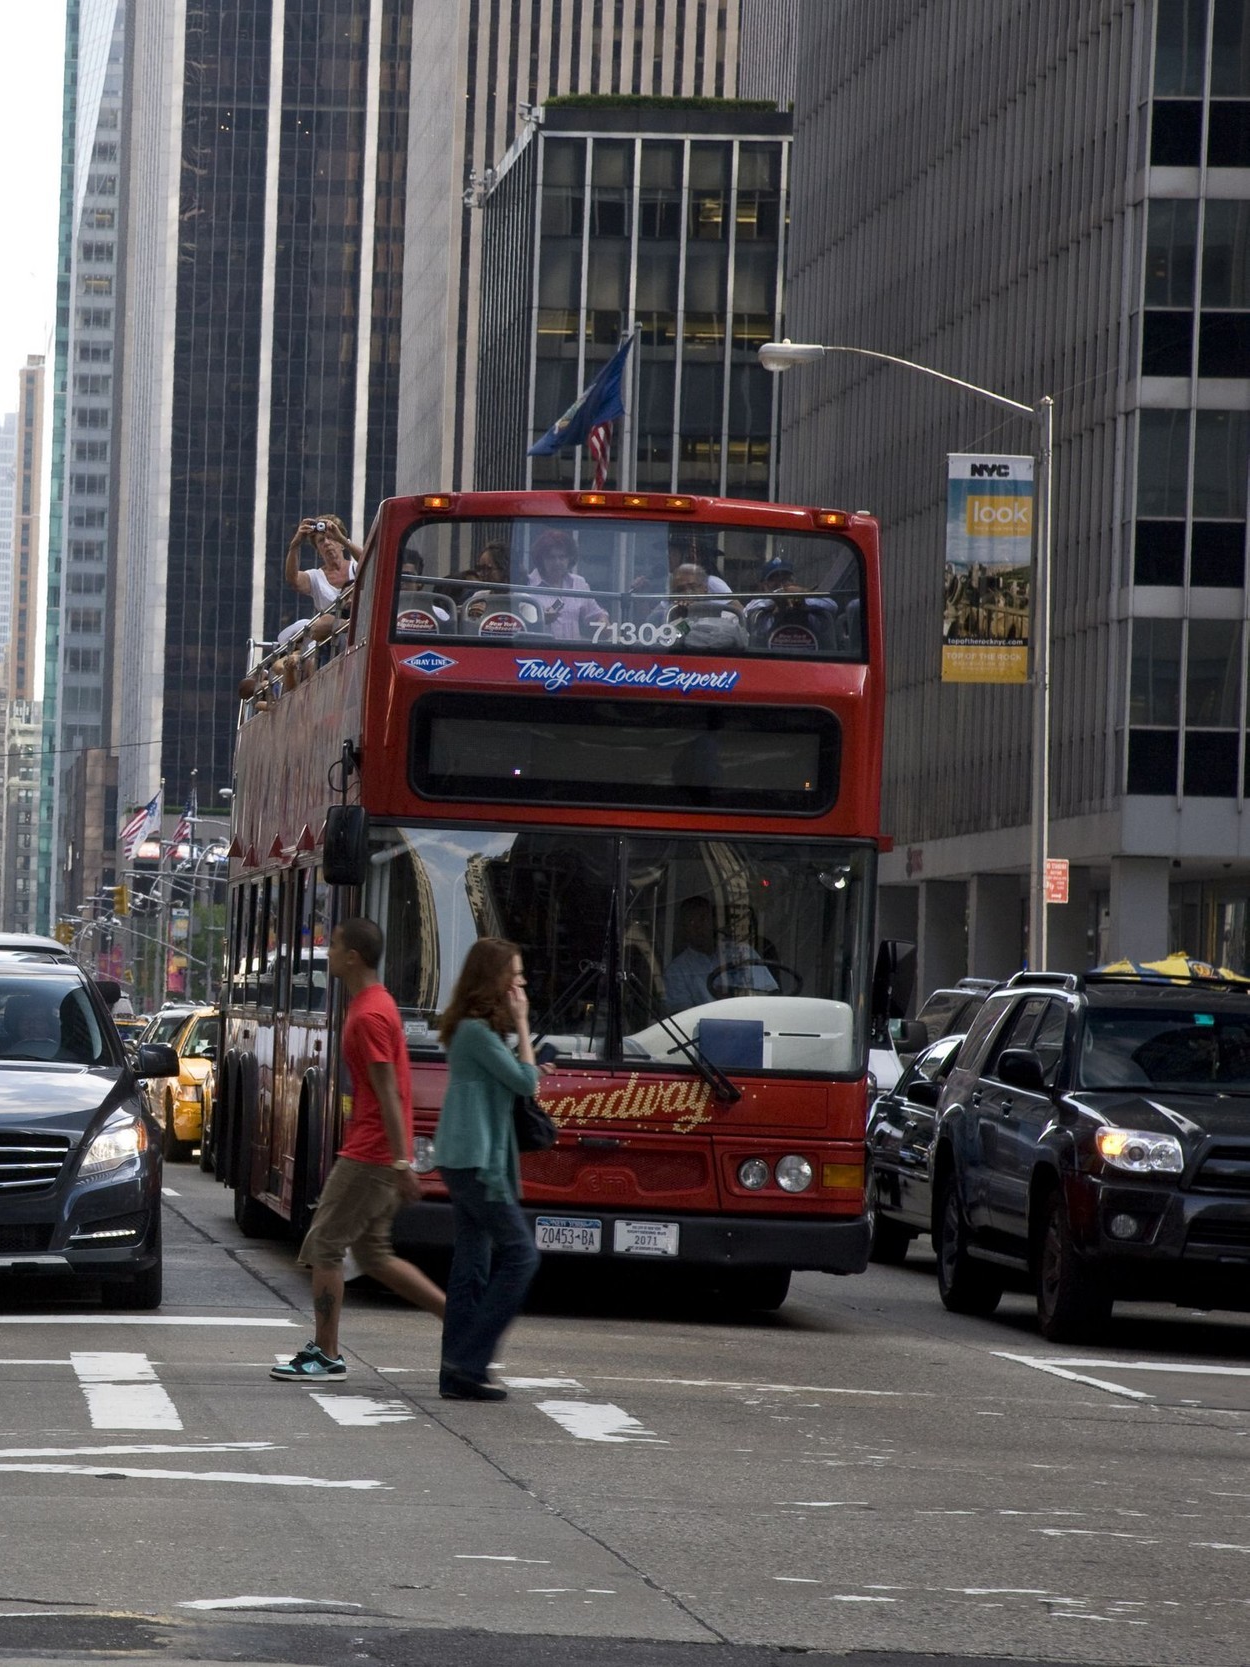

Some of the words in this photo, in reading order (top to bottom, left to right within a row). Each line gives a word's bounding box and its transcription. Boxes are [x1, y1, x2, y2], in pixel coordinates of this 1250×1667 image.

[971, 464, 1010, 477] NYC
[973, 501, 1028, 523] look
[589, 621, 677, 646] 71309
[410, 658, 430, 666] GRAY
[516, 658, 571, 689] Truly,
[574, 661, 604, 679] The
[603, 662, 658, 683] Local
[656, 667, 738, 691] Expert!
[634, 1235, 657, 1246] 2071
